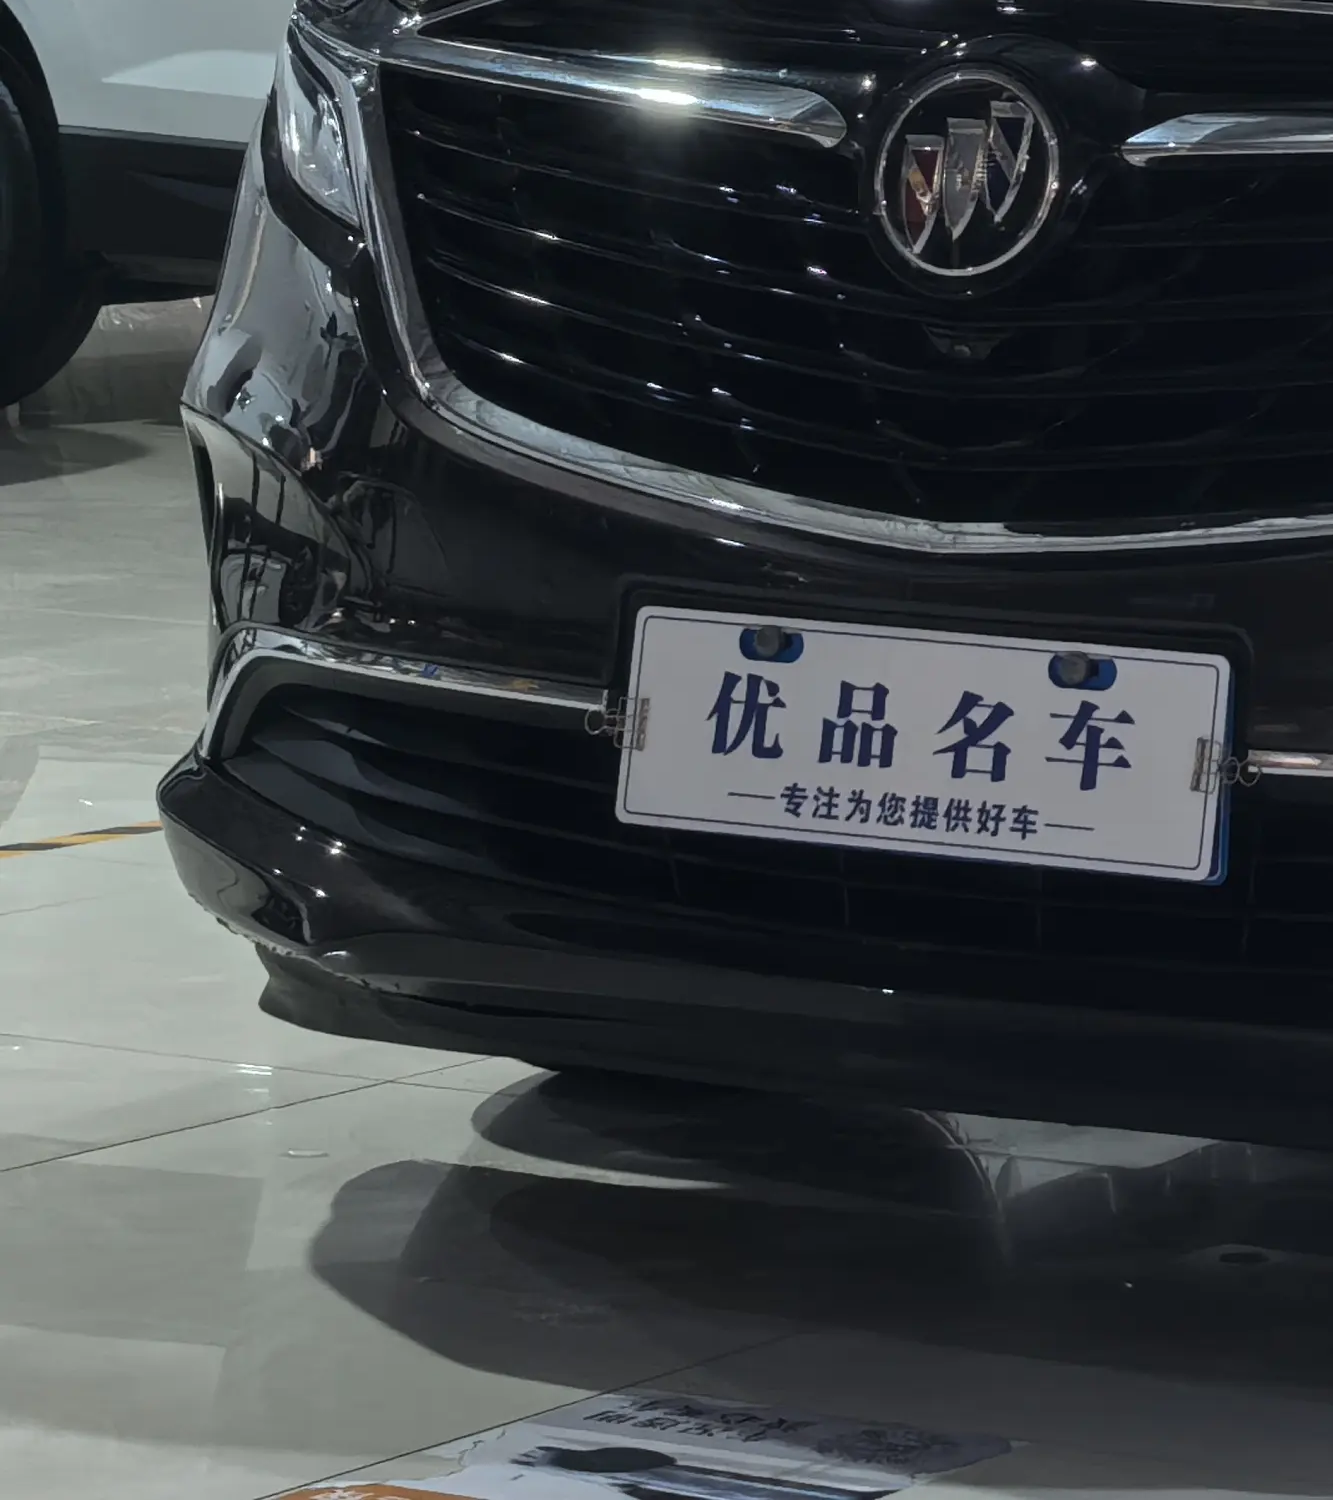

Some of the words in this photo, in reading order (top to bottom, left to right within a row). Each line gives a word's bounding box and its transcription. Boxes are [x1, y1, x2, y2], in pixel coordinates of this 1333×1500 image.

[706, 671, 1136, 791] 优品名车
[779, 783, 1040, 840] 专注为您提供好车
